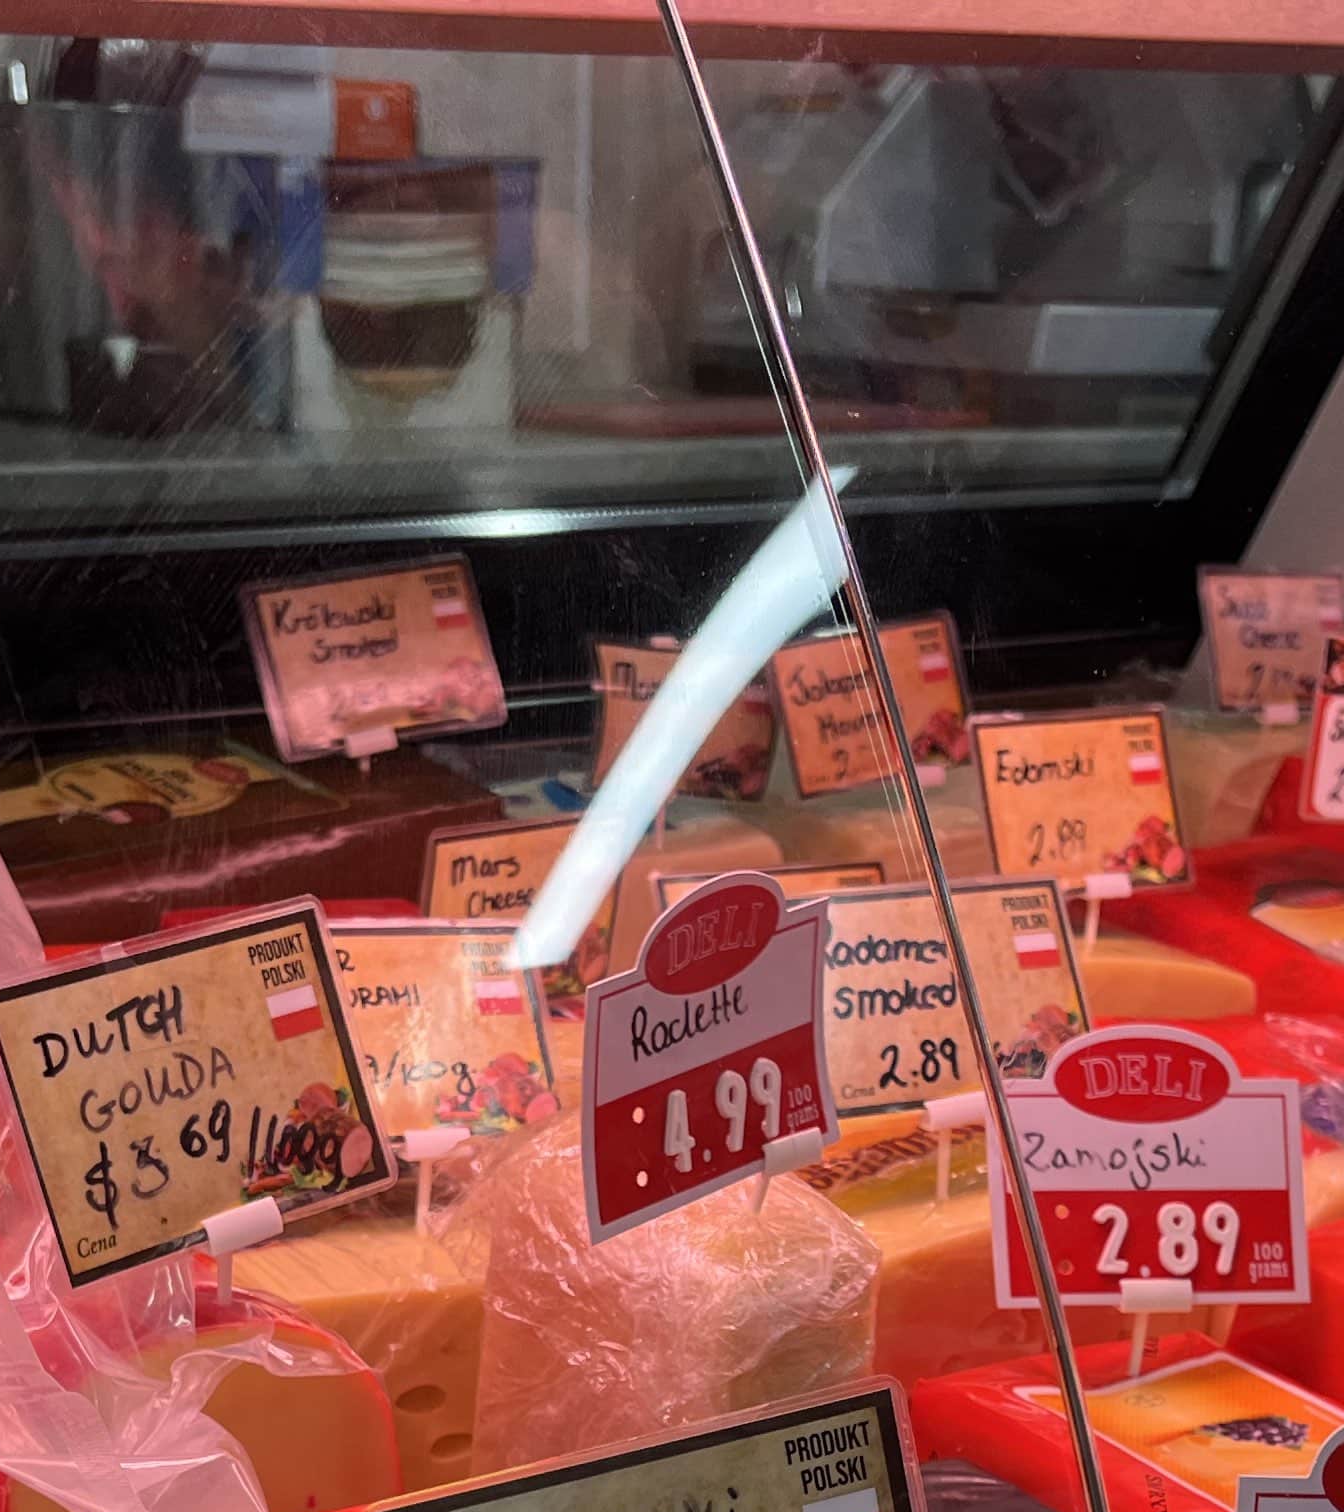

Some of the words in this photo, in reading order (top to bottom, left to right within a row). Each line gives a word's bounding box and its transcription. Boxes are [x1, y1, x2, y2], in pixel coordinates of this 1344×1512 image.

[450, 855, 521, 887] Mars
[247, 933, 304, 967] PRODUKT
[666, 902, 765, 976] DELI
[261, 959, 307, 988] POLSKI
[832, 970, 957, 1020] Smoked
[33, 985, 185, 1078] DUTCH
[879, 1035, 960, 1089] 2.89
[1079, 1053, 1207, 1101] DELI
[80, 1046, 235, 1133] GOUDA
[787, 1083, 813, 1109] 100
[663, 1056, 783, 1174] 4.99
[787, 1104, 821, 1127] grams
[76, 1233, 119, 1260] Cena
[1092, 1200, 1241, 1279] 2.89
[1253, 1242, 1284, 1261] 100
[1248, 1262, 1289, 1284] grams
[784, 1421, 872, 1466] PRODUKT
[800, 1456, 869, 1496] POLSKI
